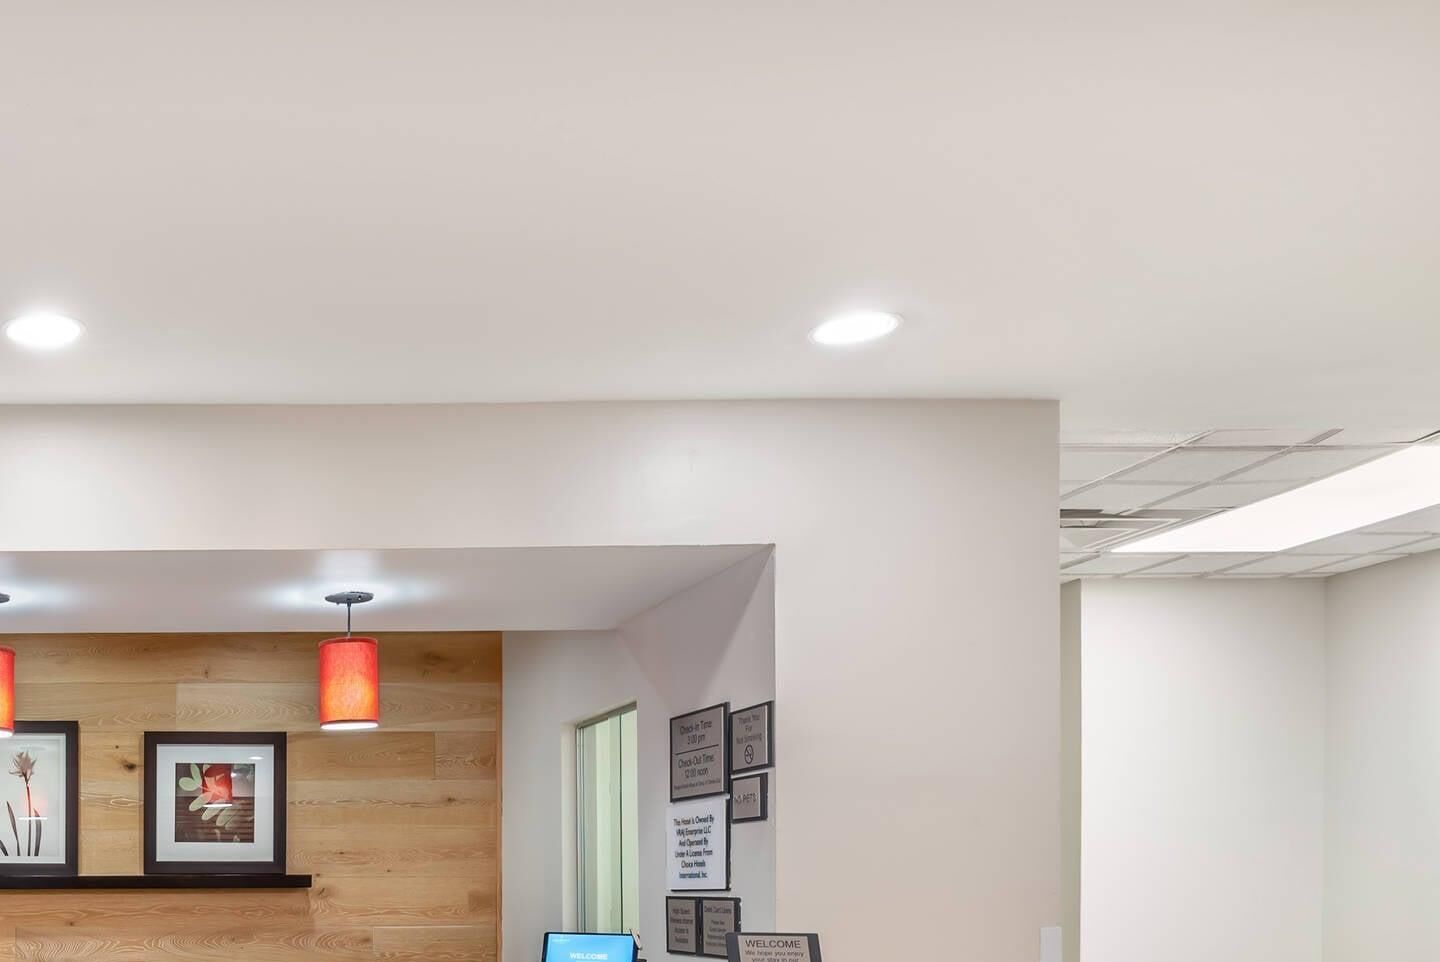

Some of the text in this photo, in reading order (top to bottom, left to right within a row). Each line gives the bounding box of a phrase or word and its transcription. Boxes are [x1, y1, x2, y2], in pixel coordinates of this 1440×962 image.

[700, 720, 713, 730] Time
[698, 734, 706, 744] pm
[678, 754, 715, 769] Check-Out Time
[697, 768, 708, 777] noon
[695, 816, 709, 824] Owned
[703, 825, 711, 834] LLC
[687, 839, 703, 847] Operated
[675, 850, 685, 858] Under
[703, 848, 713, 856] From
[745, 940, 801, 948] WELCOME
[569, 952, 608, 960] WELCOME
[757, 950, 773, 958] hope
